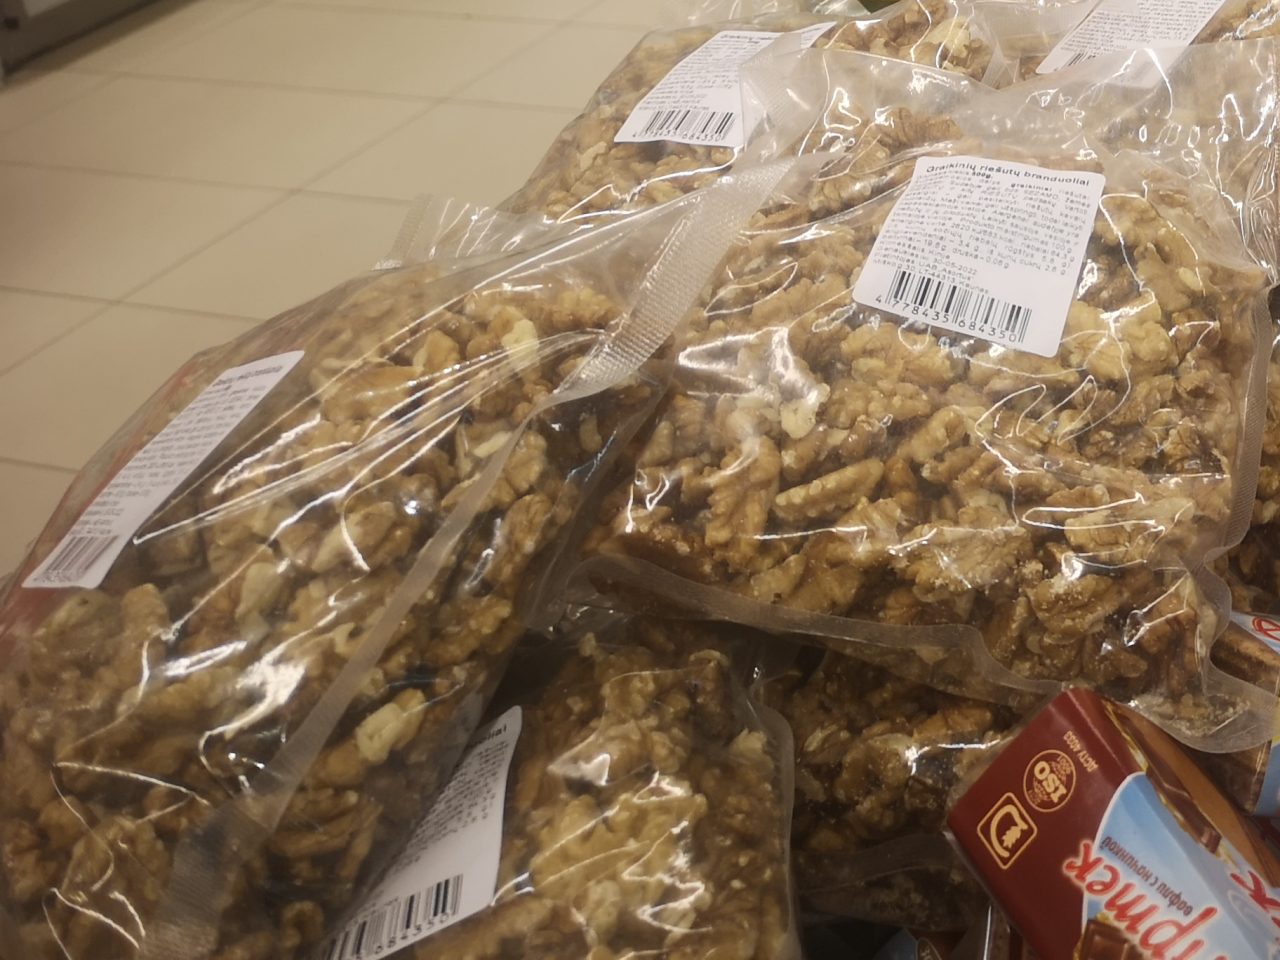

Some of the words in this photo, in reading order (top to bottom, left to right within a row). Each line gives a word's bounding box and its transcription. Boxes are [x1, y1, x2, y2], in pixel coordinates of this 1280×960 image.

[1024, 171, 1090, 187] branduoliai
[1033, 760, 1068, 802] ISO
[1100, 834, 1153, 883] начинкой
[1063, 839, 1222, 960] ртек
[1159, 880, 1195, 918] вафли
